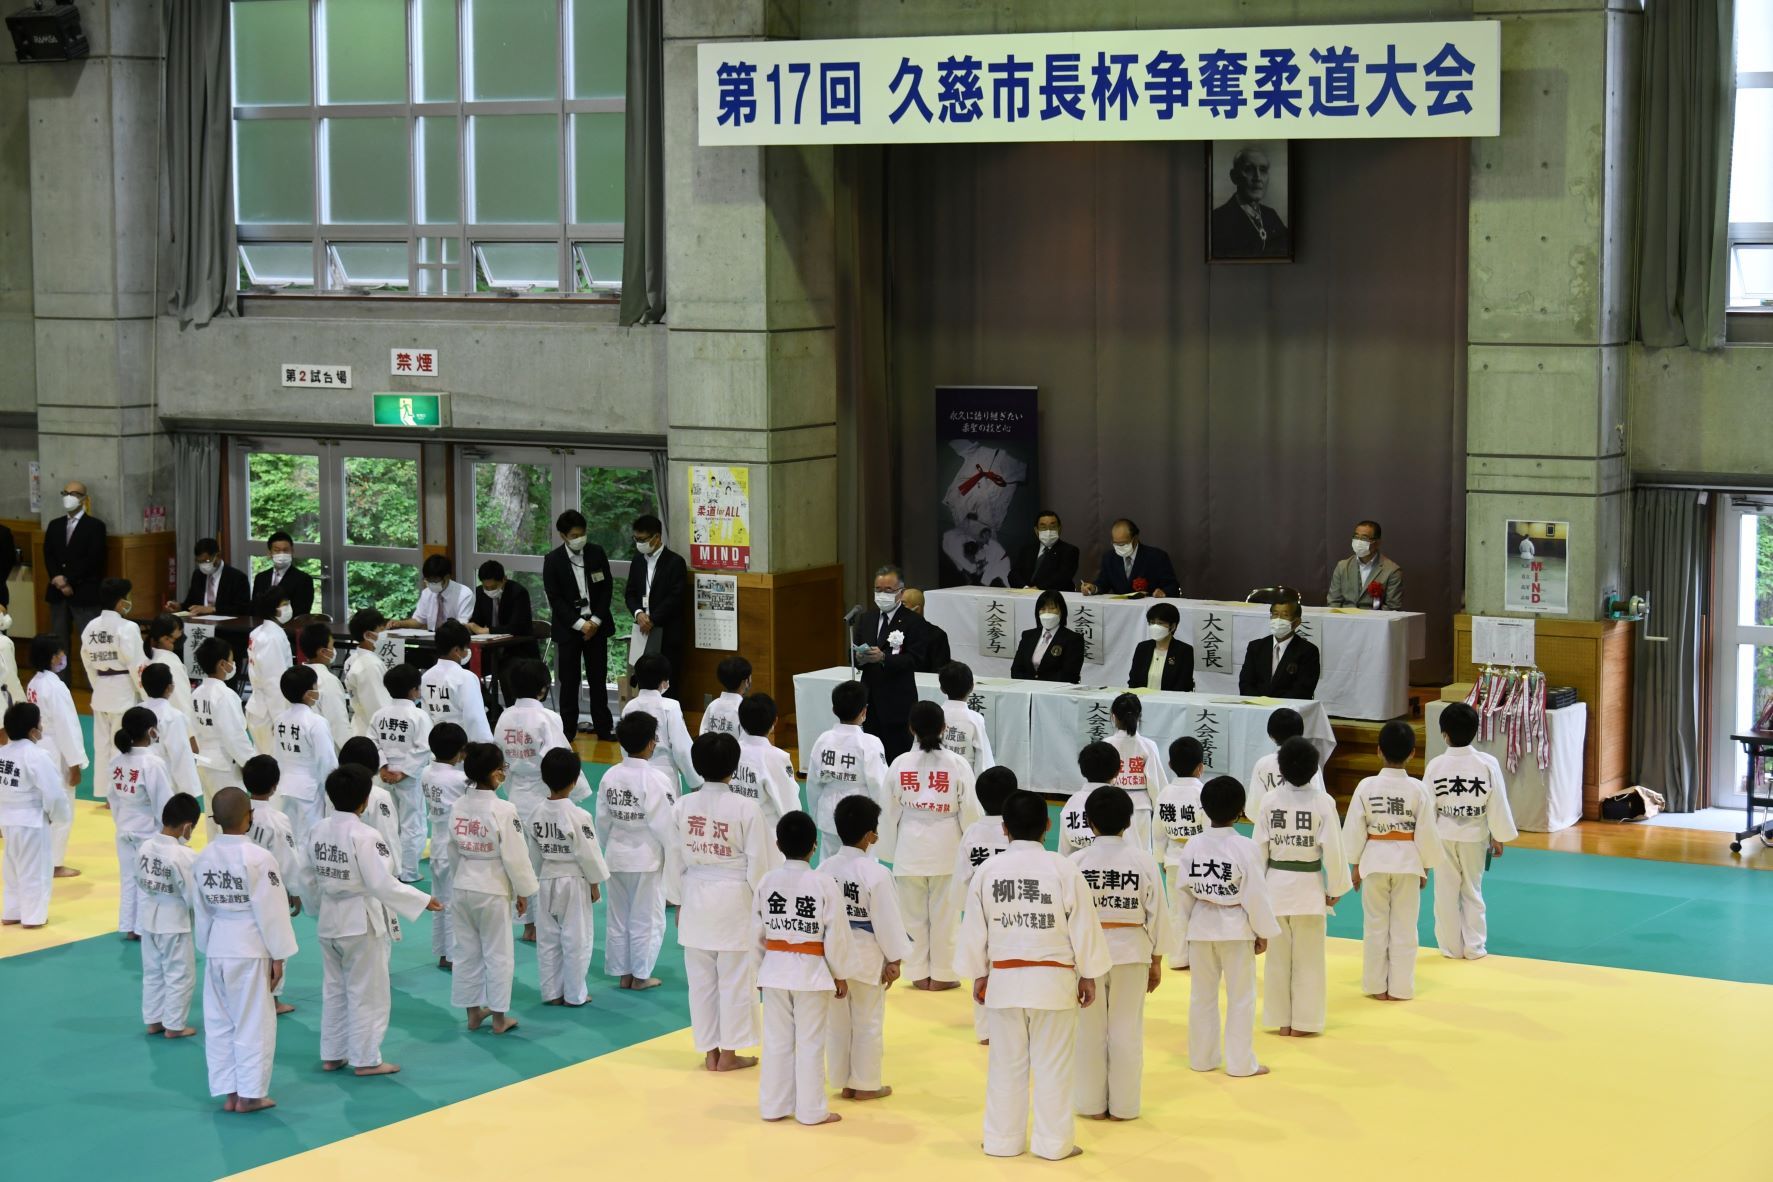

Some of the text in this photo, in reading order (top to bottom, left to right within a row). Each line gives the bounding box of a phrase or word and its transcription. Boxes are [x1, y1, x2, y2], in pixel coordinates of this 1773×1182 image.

[717, 42, 1476, 128] 第17回 久慈市長杯争奪柔道大会
[396, 353, 432, 372] 禁煙
[725, 506, 740, 517] ALL
[699, 546, 739, 561] MIND
[985, 600, 1007, 654] 大会参与
[1201, 612, 1225, 668] 大会長
[426, 684, 450, 700] 下山
[278, 721, 300, 741] 中村
[379, 717, 409, 733] 小野寺
[821, 749, 856, 769] 畑中
[1119, 756, 1145, 774] 盛
[900, 771, 950, 793] 馬場
[1433, 775, 1488, 797] 三本木
[687, 815, 729, 842] 荒沢
[1081, 869, 1140, 891] 荒津内
[767, 890, 817, 919] 金盛
[1092, 894, 1139, 910] いわて柔道塾
[765, 917, 820, 935] 一心いわて柔道塾
[993, 911, 1056, 930] 一心いわて柔道塾
